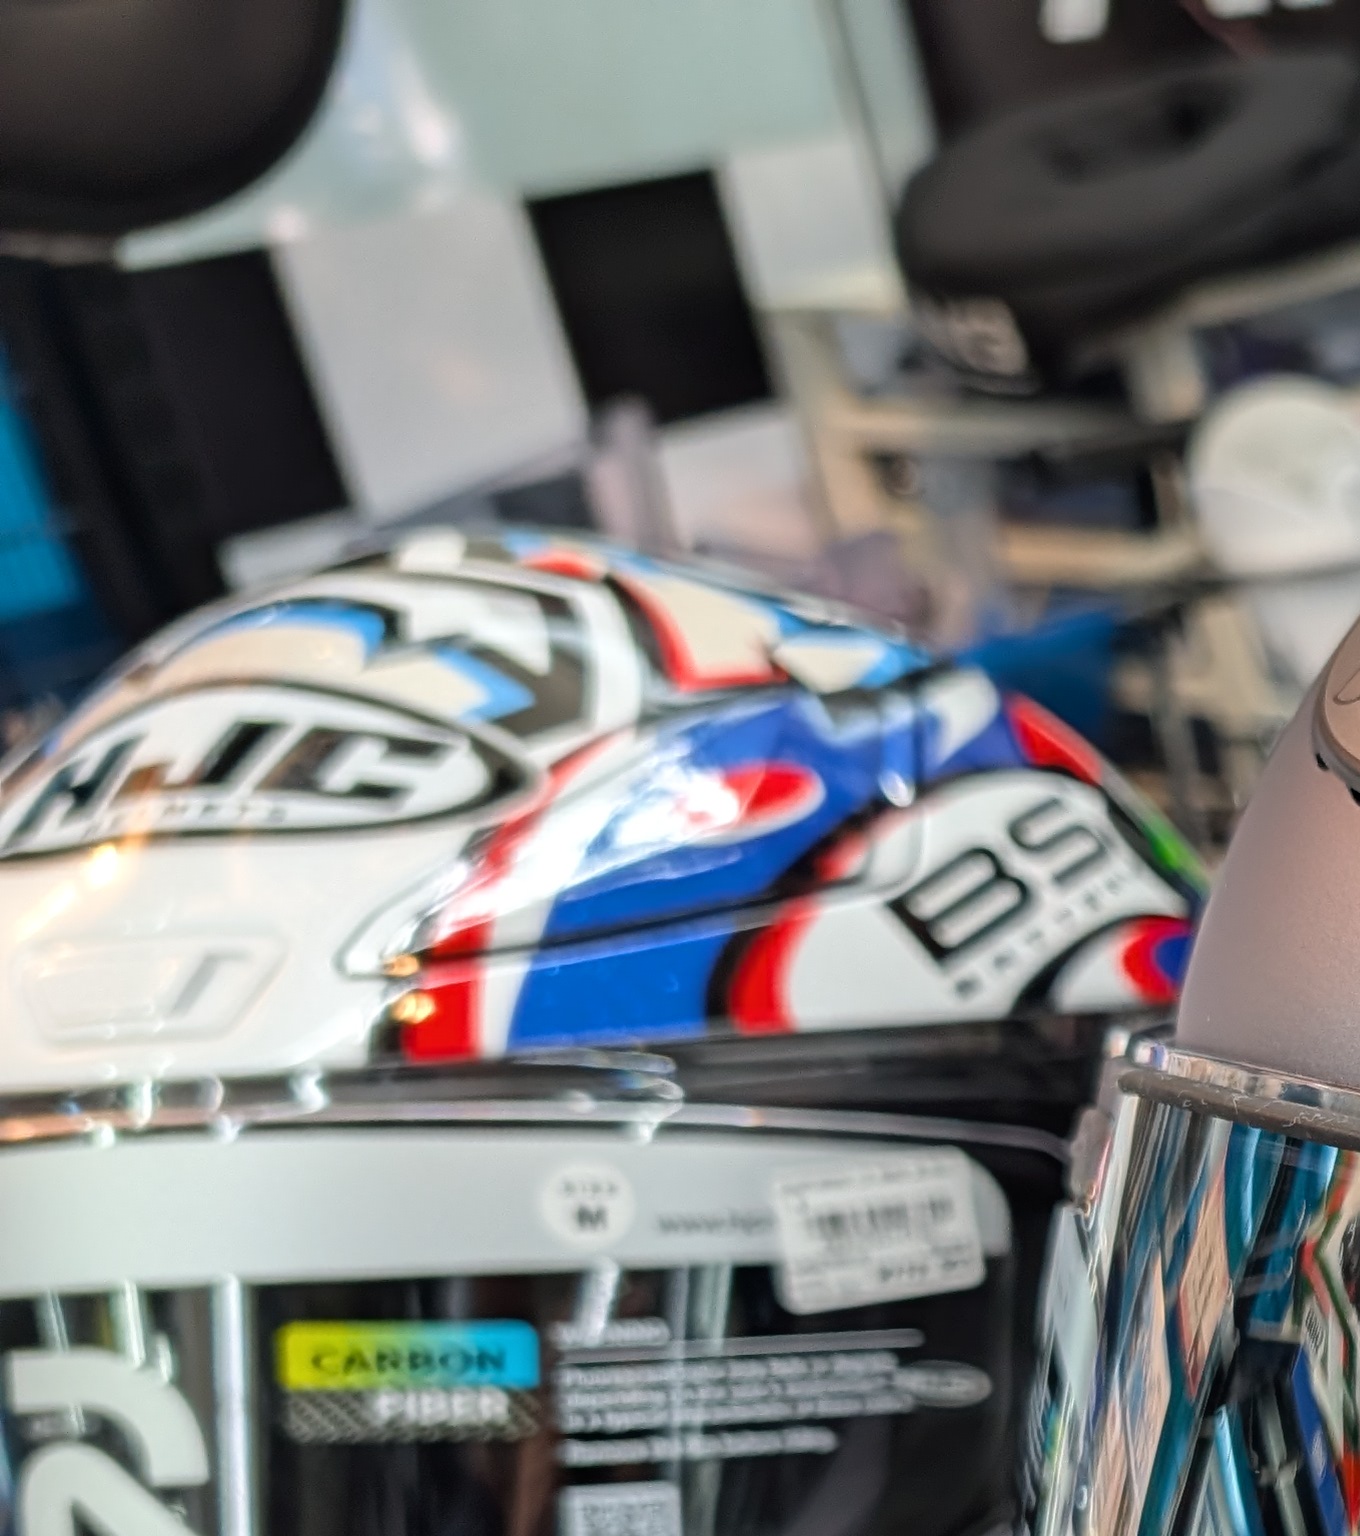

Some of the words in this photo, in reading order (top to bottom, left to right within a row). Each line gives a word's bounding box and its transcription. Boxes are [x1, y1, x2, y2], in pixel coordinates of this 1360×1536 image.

[1, 712, 455, 857] HJC
[885, 795, 1112, 968] BS
[308, 1346, 506, 1374] CARBON
